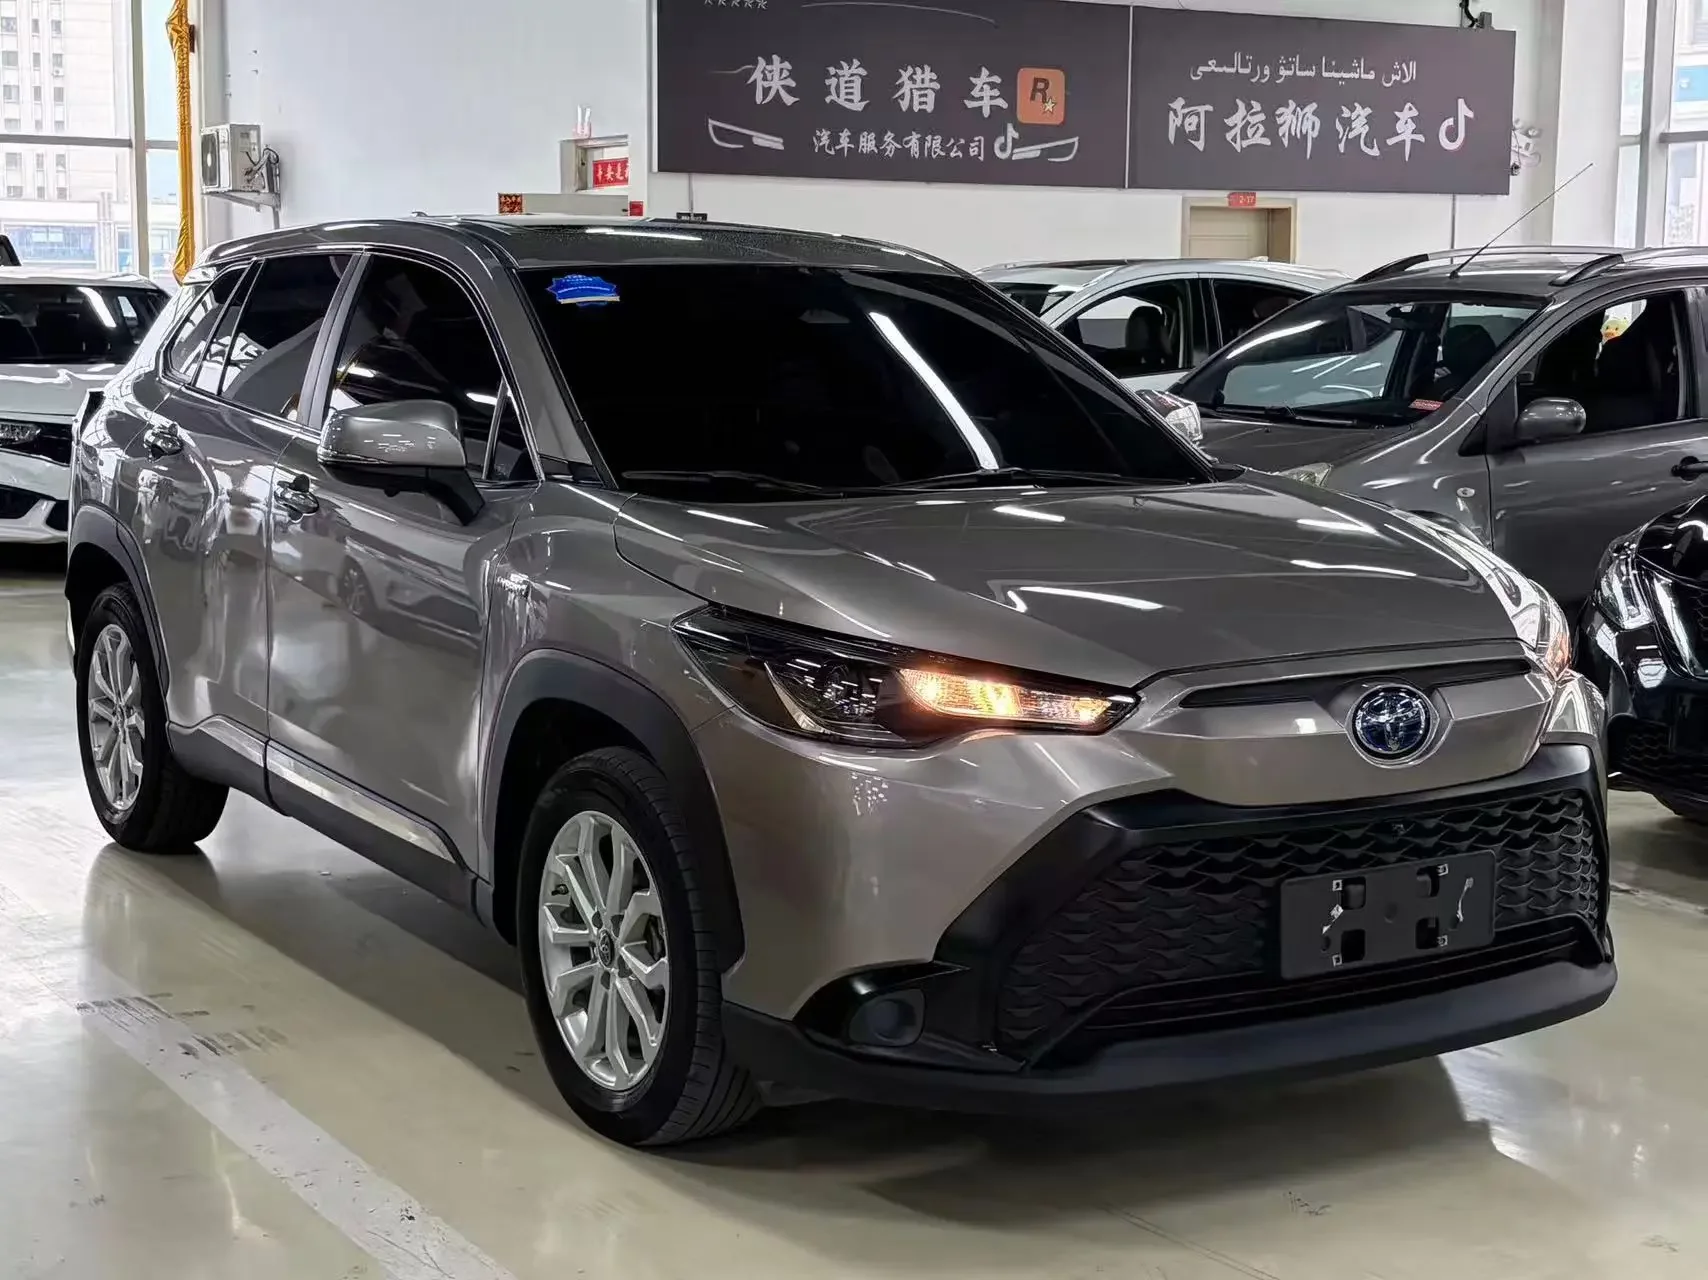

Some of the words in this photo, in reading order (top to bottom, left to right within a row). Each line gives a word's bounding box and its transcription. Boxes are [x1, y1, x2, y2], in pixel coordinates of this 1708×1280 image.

[747, 55, 1009, 119] 侠道猎车
[1030, 77, 1050, 104] R
[812, 128, 985, 162] 汽车服务有限公司
[1167, 97, 1425, 161] 阿拉狮汽车
